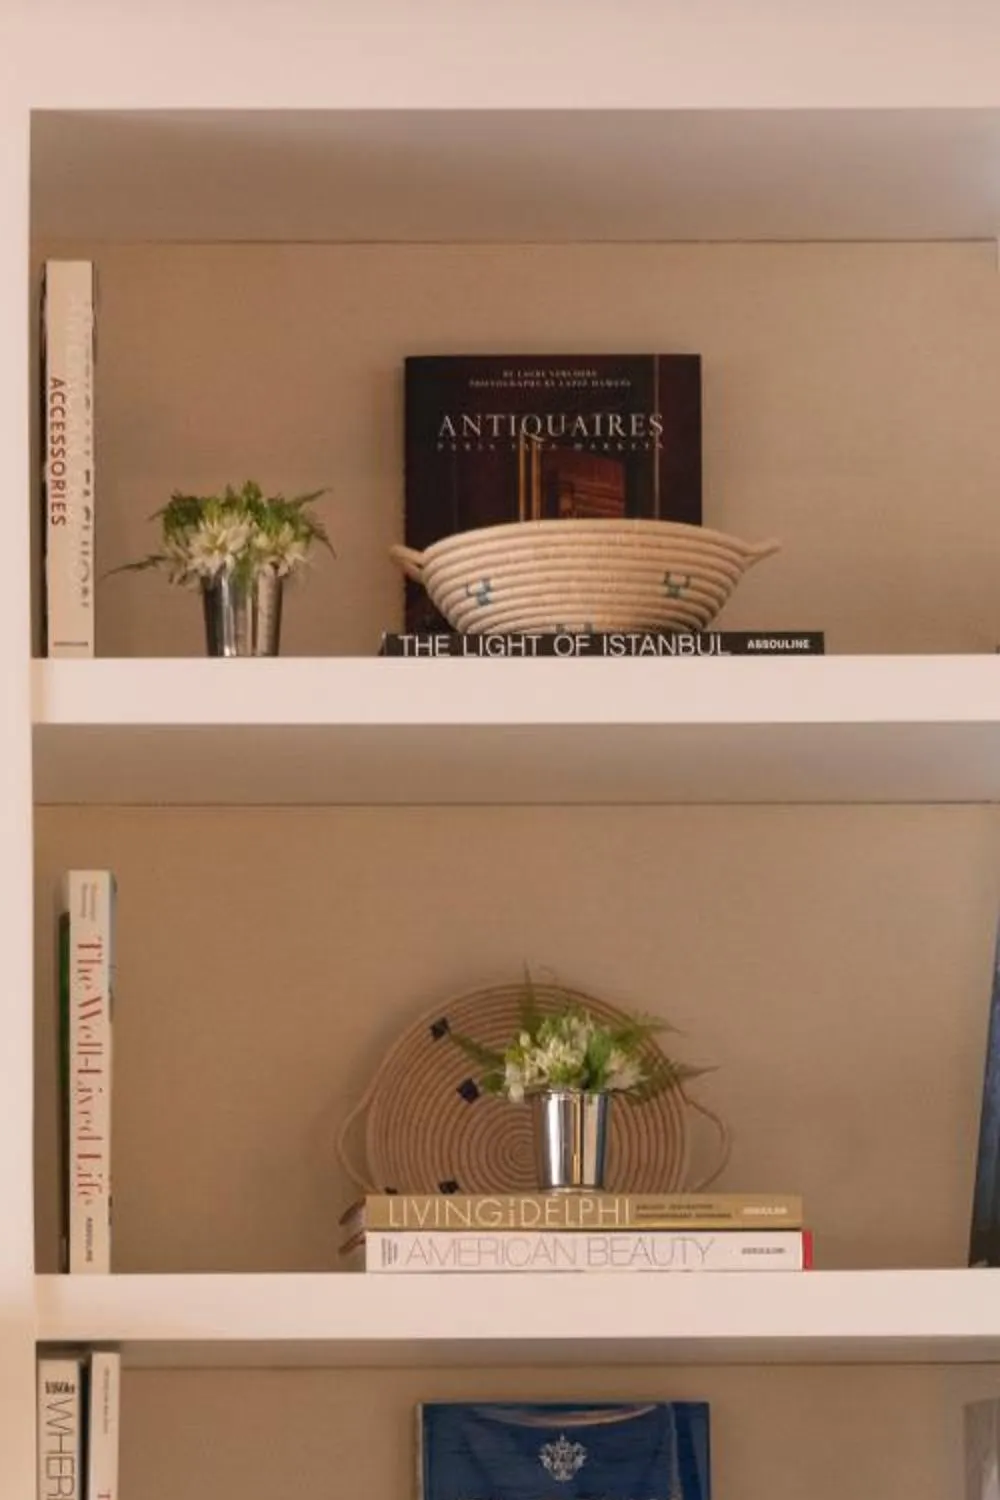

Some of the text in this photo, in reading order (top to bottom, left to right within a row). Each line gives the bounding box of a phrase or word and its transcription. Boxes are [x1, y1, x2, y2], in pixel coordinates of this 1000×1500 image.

[438, 413, 665, 442] ANTIQUAIRES
[50, 377, 67, 526] ACCESSORIES
[400, 634, 731, 656] THE LIGHT OF ISTANBUL
[746, 637, 811, 650] ASSOULINE
[77, 937, 103, 991] The
[388, 1198, 503, 1228] LIVING
[520, 1198, 631, 1228] DELPHI
[405, 1237, 579, 1267] AMERICAN
[586, 1237, 716, 1267] BEAUTY
